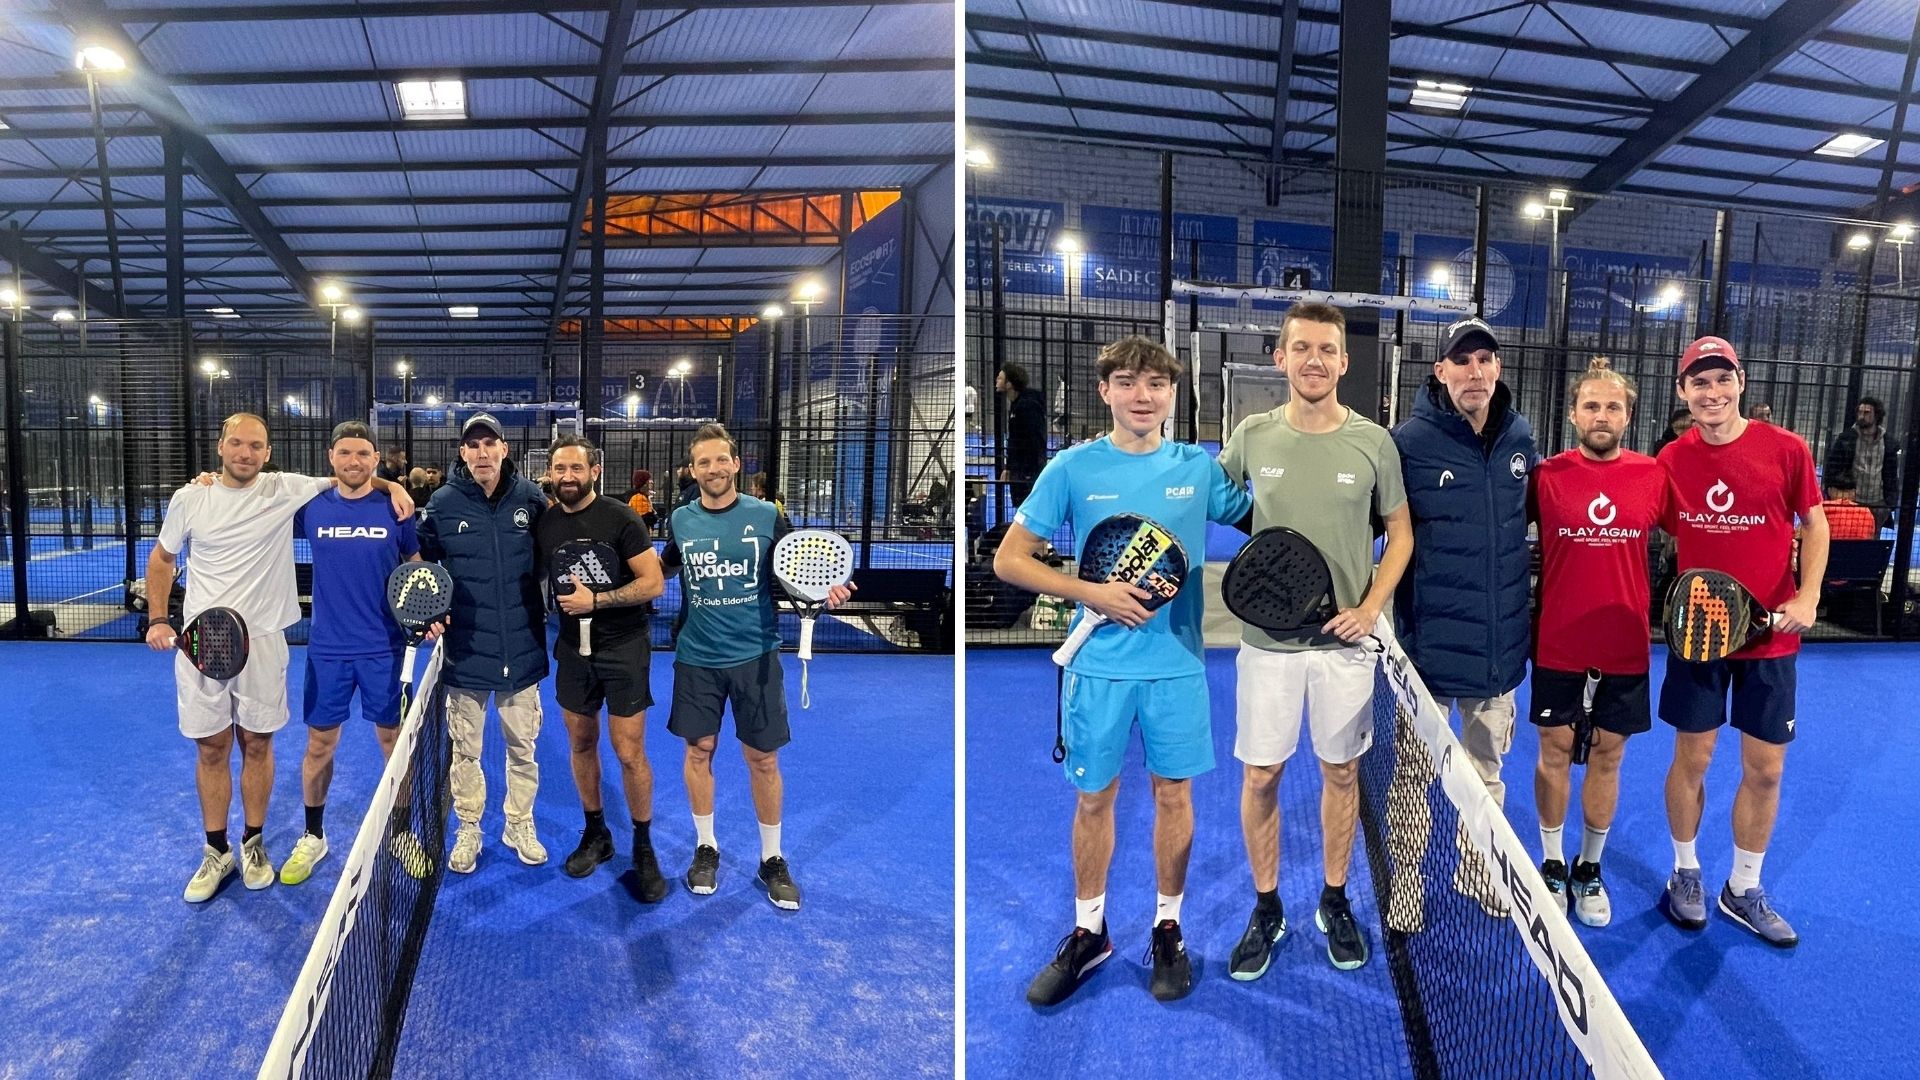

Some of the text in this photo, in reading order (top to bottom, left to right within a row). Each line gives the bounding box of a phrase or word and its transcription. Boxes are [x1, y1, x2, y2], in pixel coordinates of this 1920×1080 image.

[1290, 274, 1302, 289] 4
[1357, 298, 1386, 306] HEAD
[1439, 304, 1467, 312] HEAD
[635, 374, 645, 390] 3
[459, 390, 533, 403] KIMBO
[1678, 511, 1766, 525] PLAY AGAIN
[317, 527, 388, 539] HEAD
[1558, 527, 1641, 539] PLAY AGAIN
[688, 551, 718, 565] we
[693, 558, 748, 581] padel
[703, 596, 721, 606] Club
[1489, 829, 1588, 1036] HEAD
